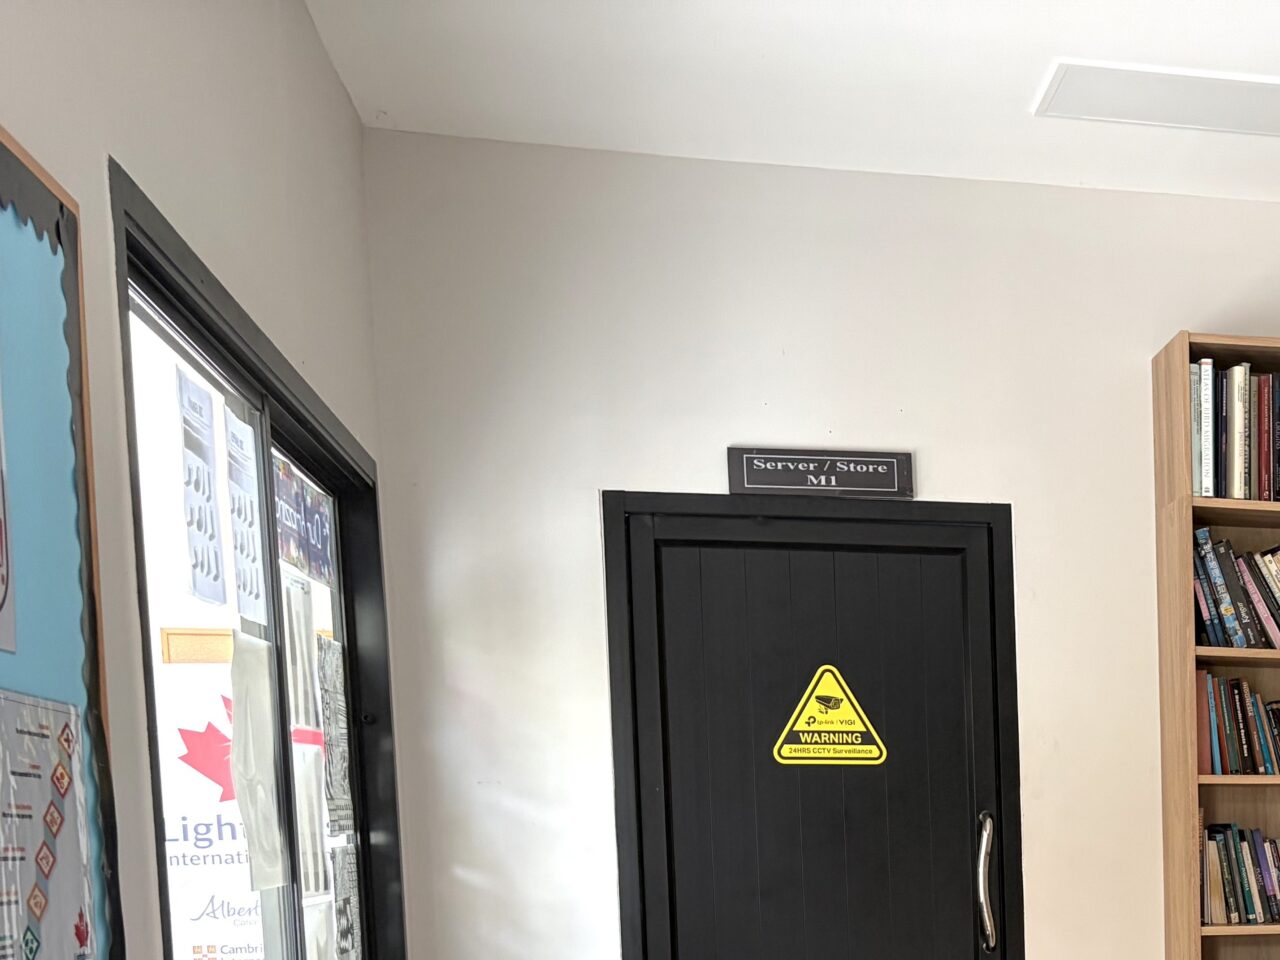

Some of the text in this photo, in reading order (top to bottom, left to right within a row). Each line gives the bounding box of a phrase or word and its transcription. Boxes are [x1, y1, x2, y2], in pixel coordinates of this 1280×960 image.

[1203, 393, 1210, 404] OF
[753, 458, 888, 473] Server / Store
[807, 475, 837, 486] M1
[799, 732, 862, 744] WARNING
